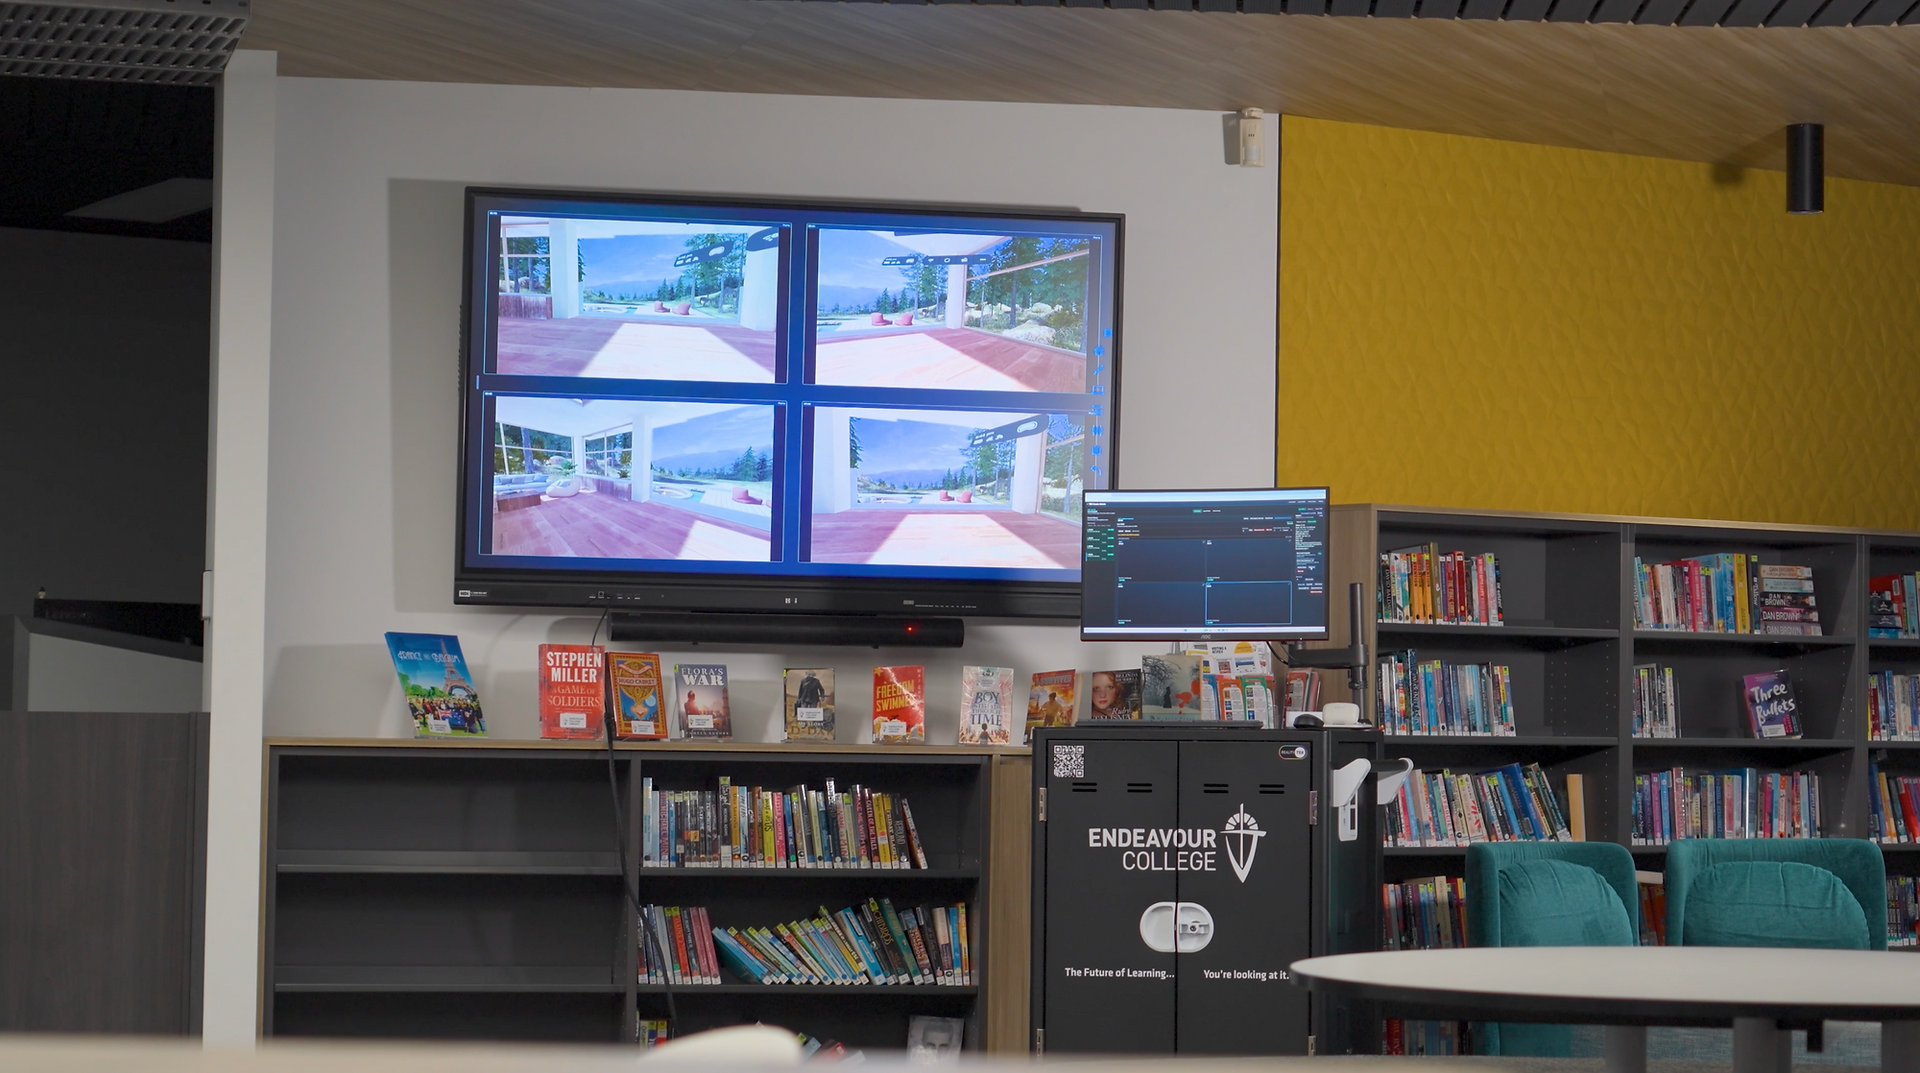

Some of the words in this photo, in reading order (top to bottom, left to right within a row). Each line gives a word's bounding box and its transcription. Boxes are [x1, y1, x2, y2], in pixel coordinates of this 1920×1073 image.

[1763, 611, 1776, 620] DAN
[1776, 612, 1798, 620] BROWN
[1767, 626, 1779, 634] DAN
[1780, 626, 1802, 635] BROWN
[547, 651, 602, 667] STEPHEN
[551, 667, 597, 683] MILLER
[681, 668, 724, 676] FLORA'S
[682, 675, 725, 686] WAR
[557, 684, 586, 694] GAME
[876, 680, 915, 699] FREEDOM
[1750, 684, 1788, 704] Three
[547, 695, 601, 707] SOLDIERS
[876, 695, 913, 712] SWIMME
[975, 691, 1000, 704] BOY
[1112, 706, 1131, 715] Ruby
[1756, 698, 1796, 727] Bullets
[970, 714, 1002, 726] TIME
[858, 812, 864, 824] ME
[886, 809, 894, 833] FRIDAY
[895, 820, 905, 845] REBOUND
[1089, 828, 1217, 848] ENDEAVOUR
[1122, 851, 1217, 871] COLLEGE
[1064, 967, 1082, 977] The
[1084, 968, 1114, 978] Future
[1115, 967, 1126, 977] of
[1127, 968, 1175, 980] Learning...
[1203, 969, 1232, 980] You're
[1233, 969, 1267, 982] looking
[1268, 971, 1278, 980] at
